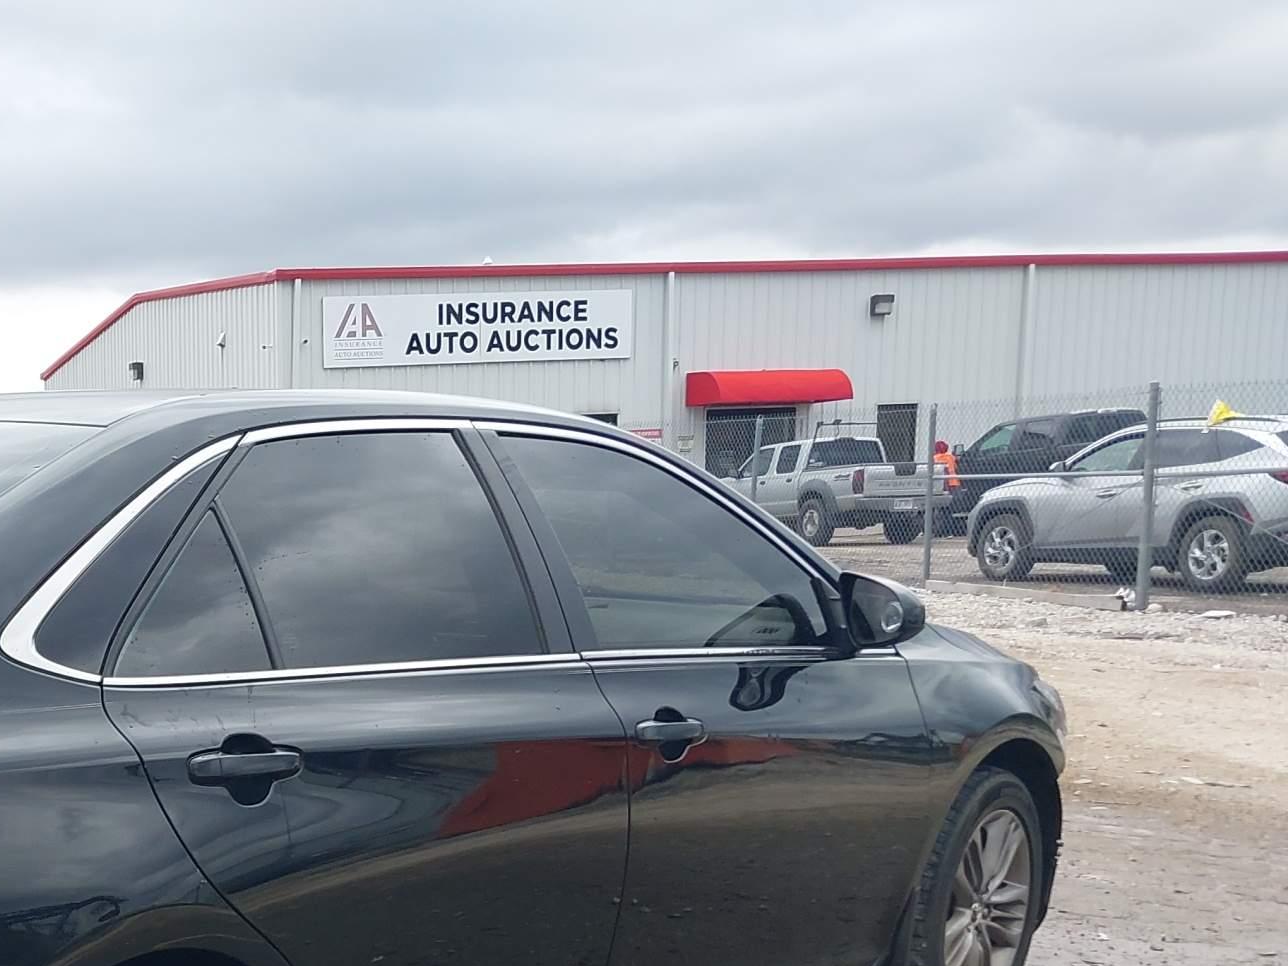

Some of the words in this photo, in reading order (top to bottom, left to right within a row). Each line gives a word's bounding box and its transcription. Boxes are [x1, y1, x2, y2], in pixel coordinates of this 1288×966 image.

[438, 299, 588, 325] INSURANCE
[405, 331, 478, 355] AUTO
[486, 327, 619, 353] AUCTIONS
